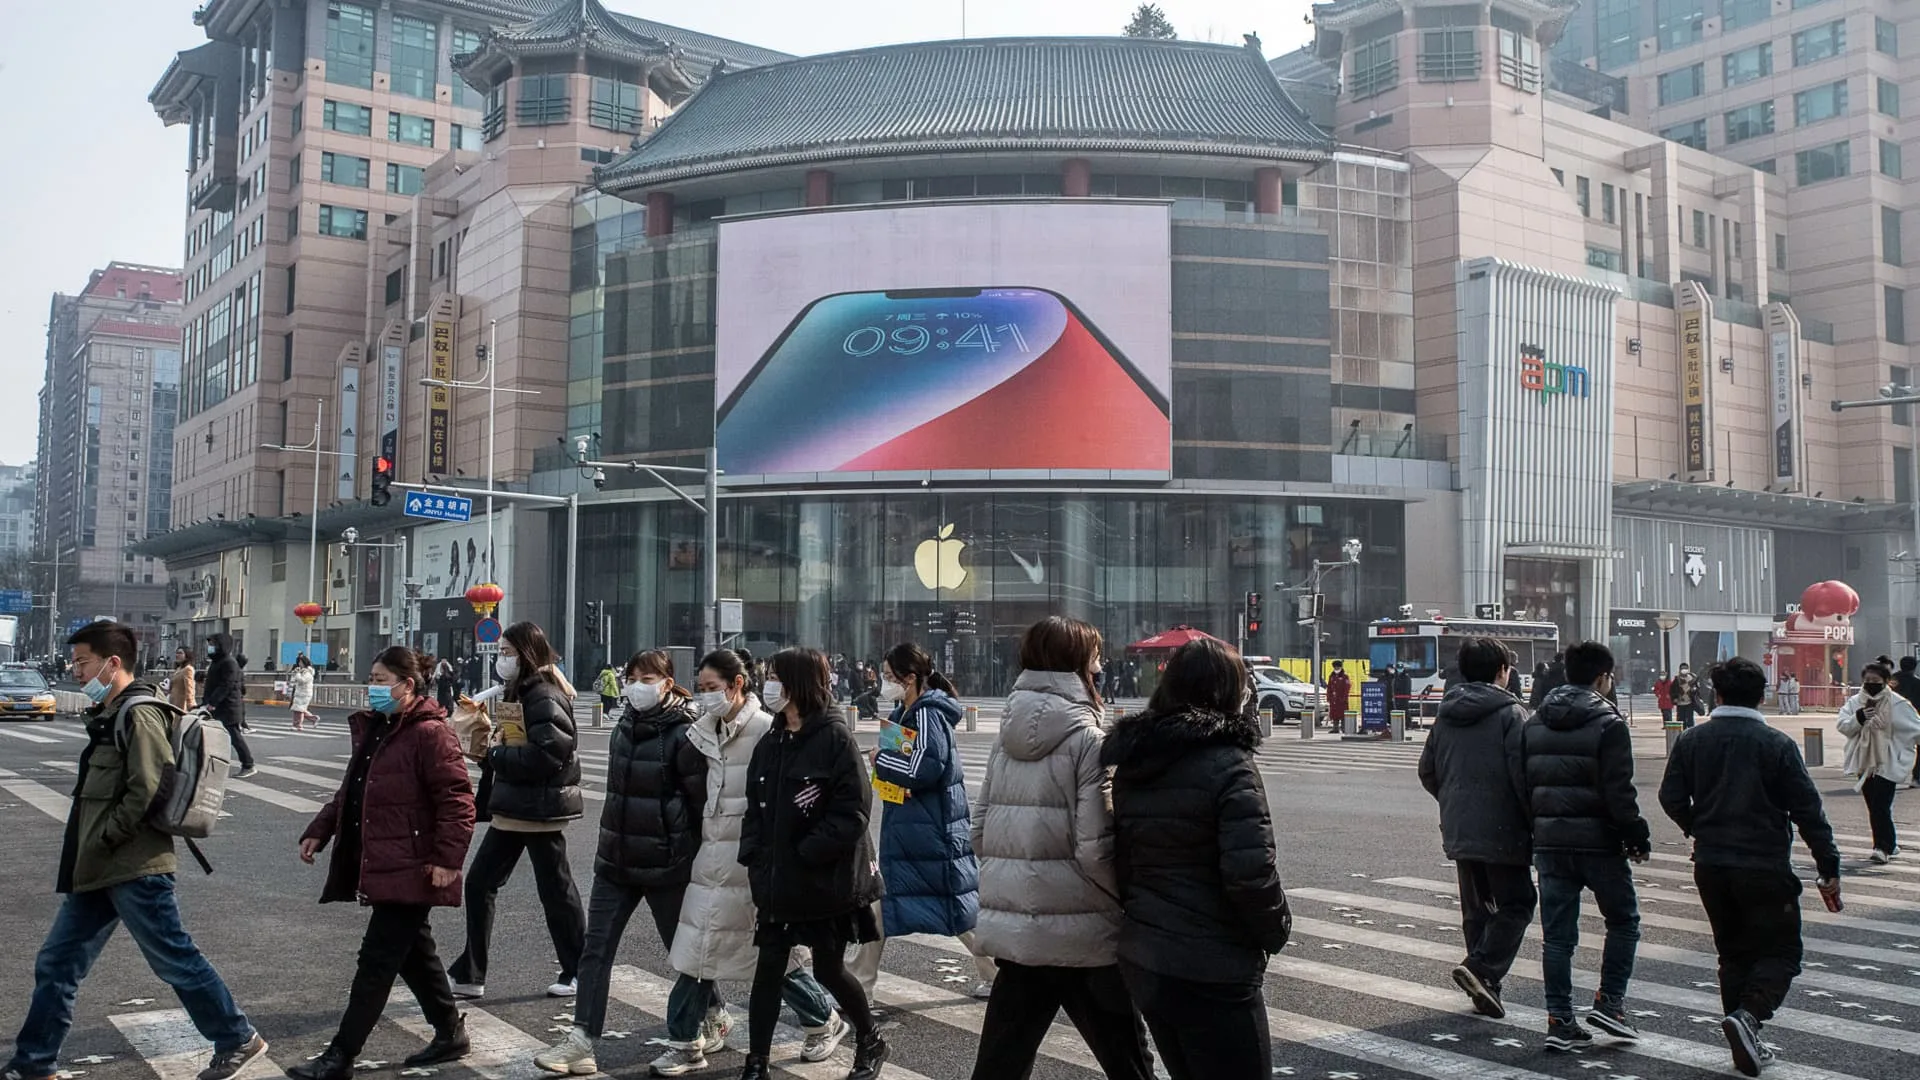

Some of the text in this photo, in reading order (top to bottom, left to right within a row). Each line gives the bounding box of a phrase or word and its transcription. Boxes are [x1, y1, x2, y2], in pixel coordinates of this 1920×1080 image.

[953, 312, 982, 320] 10%
[843, 323, 1031, 357] 09:41
[1521, 357, 1589, 406] apm
[424, 498, 468, 512] 金鱼胡同
